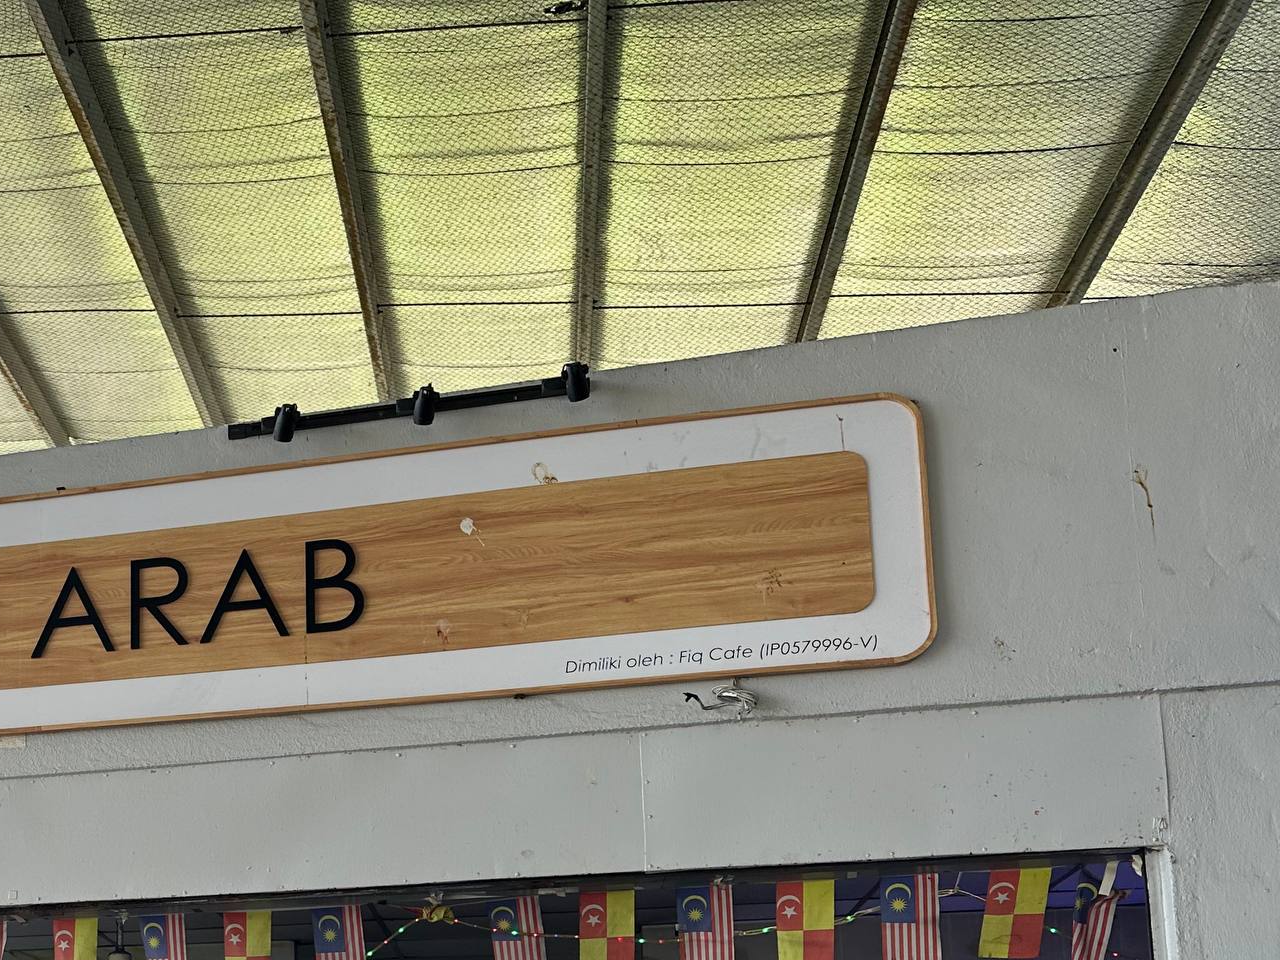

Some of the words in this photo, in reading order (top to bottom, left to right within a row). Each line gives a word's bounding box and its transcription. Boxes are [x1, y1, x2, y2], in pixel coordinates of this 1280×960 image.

[34, 537, 363, 660] ARAB
[565, 656, 621, 674] Dimiliki
[626, 652, 663, 668] oleh
[679, 649, 703, 665] Fiq
[709, 642, 753, 662] Cafe
[760, 635, 878, 660] (IP0579996-V)
